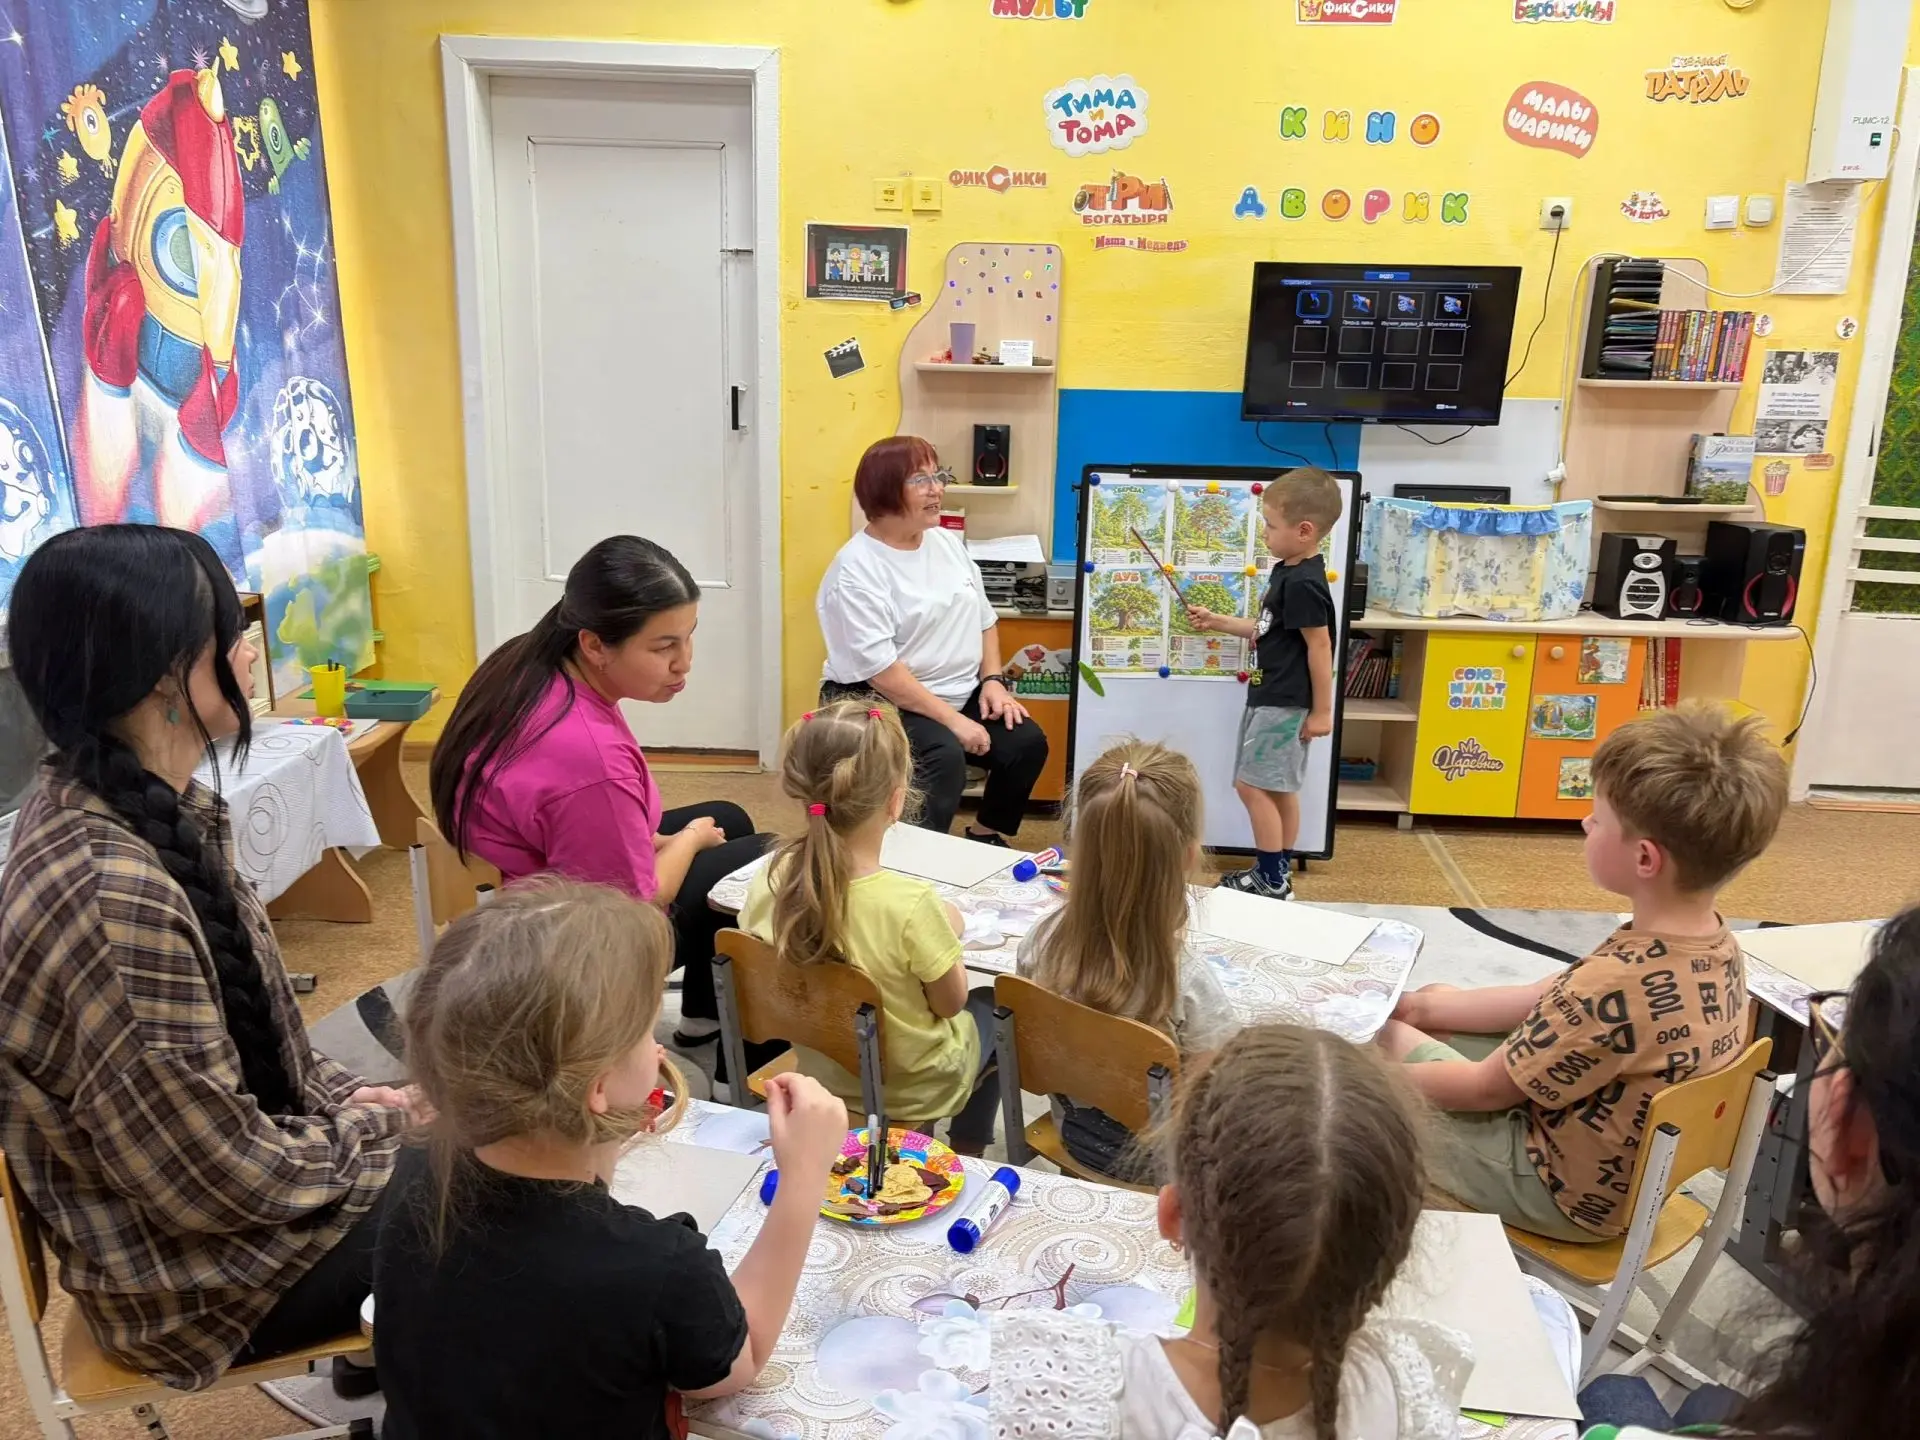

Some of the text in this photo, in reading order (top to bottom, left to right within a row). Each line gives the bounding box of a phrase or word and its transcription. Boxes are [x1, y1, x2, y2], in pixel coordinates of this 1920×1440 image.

[1645, 69, 1750, 104] ПАТРУЛЬ
[1052, 88, 1137, 117] ТИМА
[1523, 89, 1592, 122] МАЛЫ
[1058, 113, 1137, 144] ТОМА
[1507, 107, 1592, 149] ШАРИКИ
[949, 165, 1047, 194] ФИКСИКИ
[1080, 176, 1168, 211] ТРИ
[1082, 213, 1168, 225] БОГАТЫРЯ
[1096, 236, 1126, 248] Маша
[1137, 237, 1187, 251] Медведь
[1450, 682, 1506, 695] МУЛЬТ
[1454, 667, 1504, 681] СОЮЗ
[1449, 696, 1504, 708] ФИЛЬМ
[1433, 745, 1504, 781] Царевны
[1640, 969, 1685, 1022] COOL
[1711, 1025, 1741, 1059] BEST
[1546, 1049, 1602, 1086] COOL
[1527, 1077, 1561, 1102] DOG
